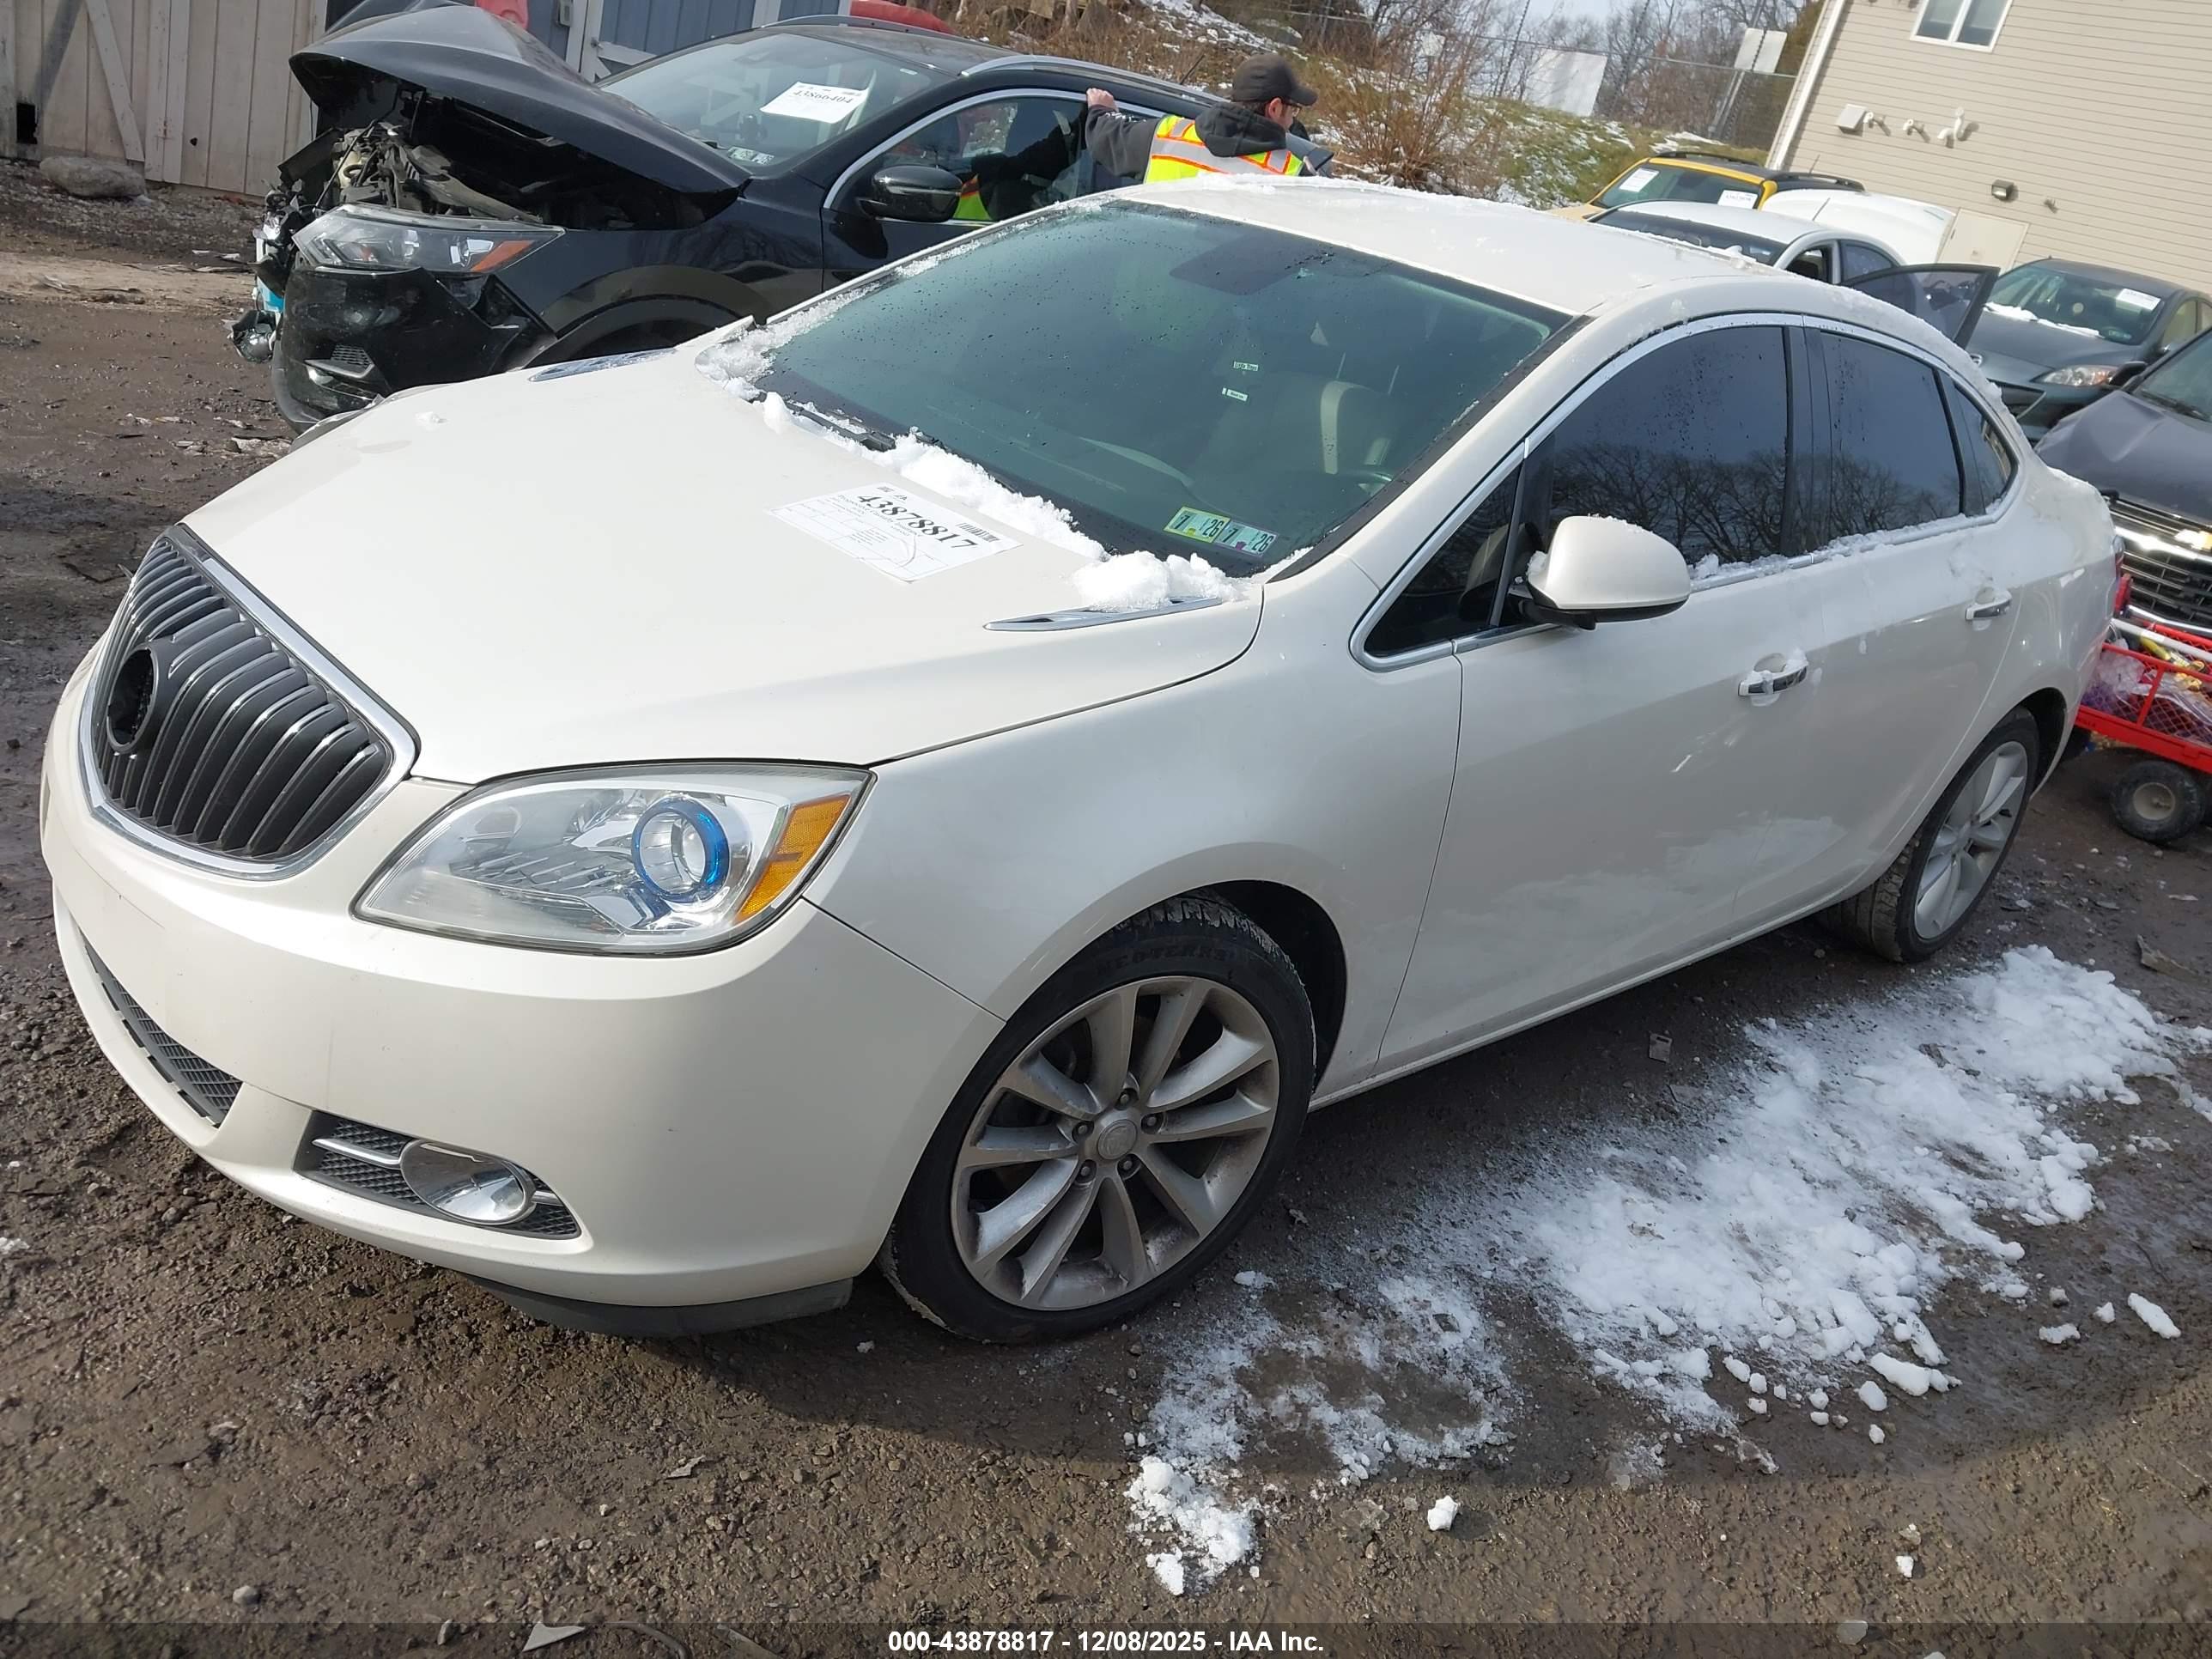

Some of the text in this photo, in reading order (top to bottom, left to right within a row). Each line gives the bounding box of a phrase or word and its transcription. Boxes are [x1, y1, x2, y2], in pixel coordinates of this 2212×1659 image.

[859, 495, 979, 549] 43878817
[1174, 515, 1190, 529] 7
[1202, 519, 1224, 538] 26
[1222, 528, 1239, 543] 7
[1251, 533, 1274, 552] 26
